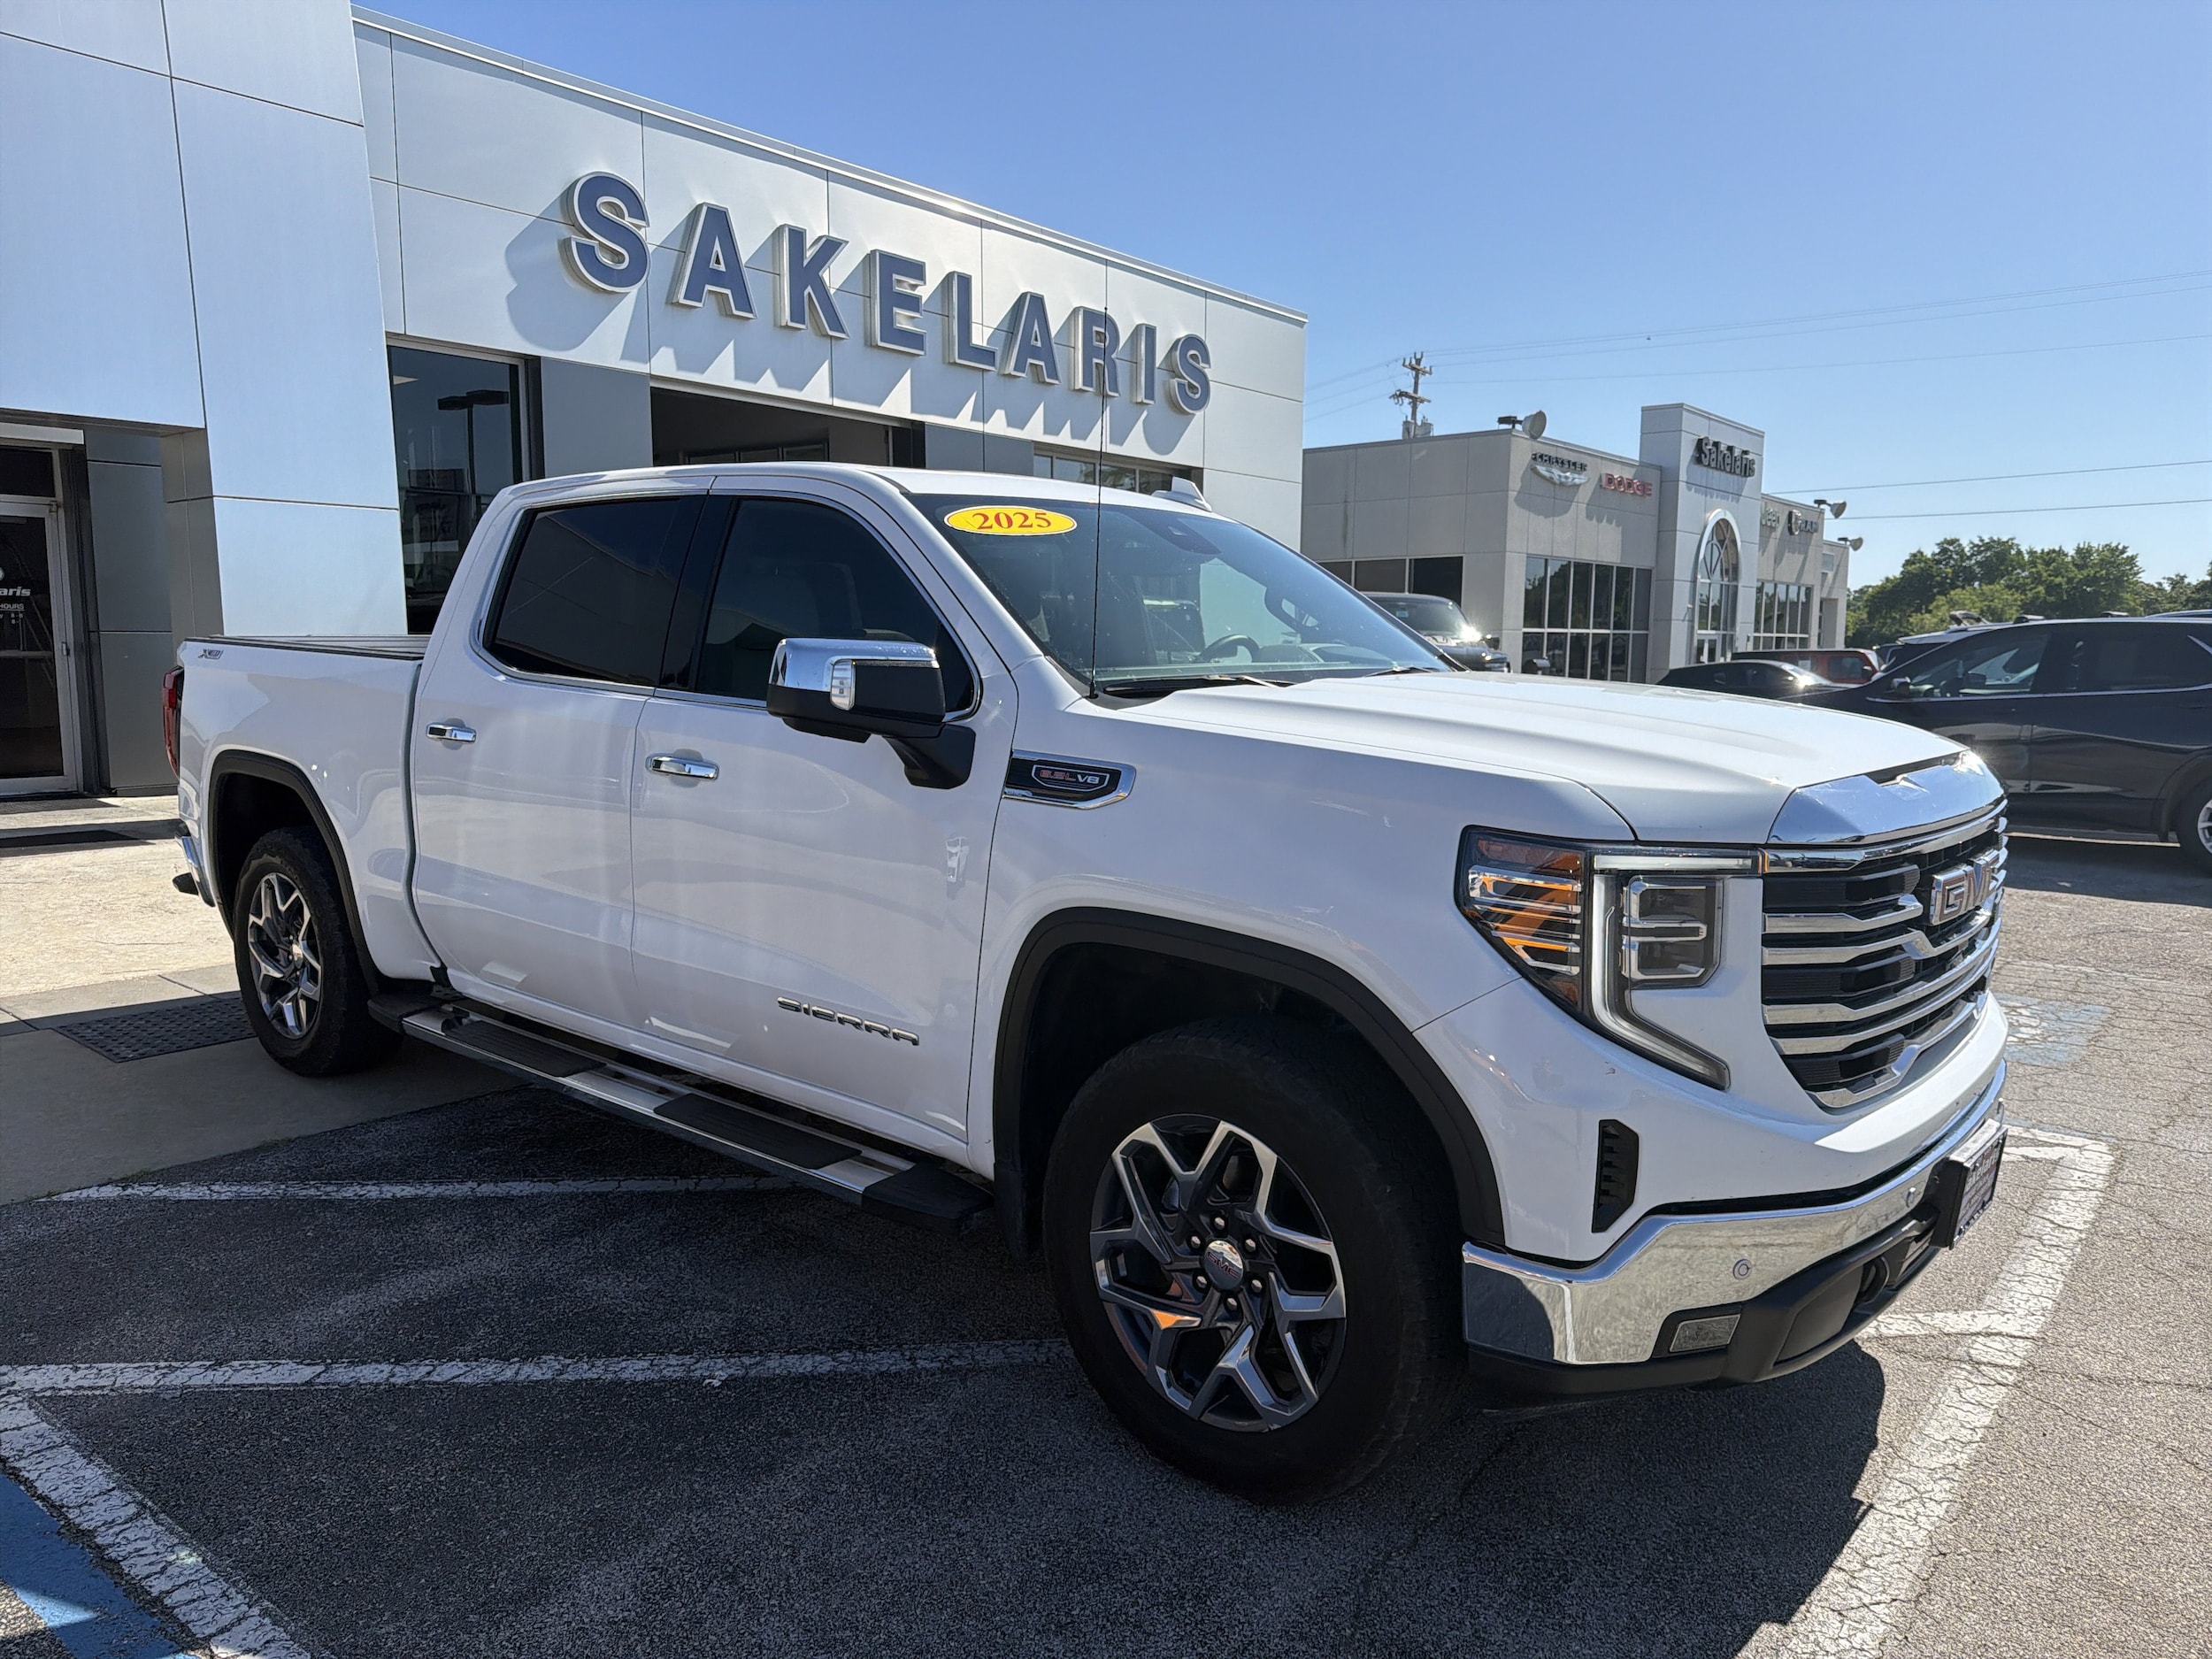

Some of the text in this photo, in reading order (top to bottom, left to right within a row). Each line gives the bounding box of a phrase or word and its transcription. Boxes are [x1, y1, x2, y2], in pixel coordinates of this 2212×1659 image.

[564, 167, 1211, 415] SAKELARIS
[1532, 452, 1588, 472] CHRYSLER
[1698, 436, 1755, 477] Sakelaris
[1601, 472, 1653, 496] DODGE
[972, 512, 1052, 530] 2025
[777, 996, 919, 1046] SIERRA
[1207, 1251, 1240, 1279] GMC
